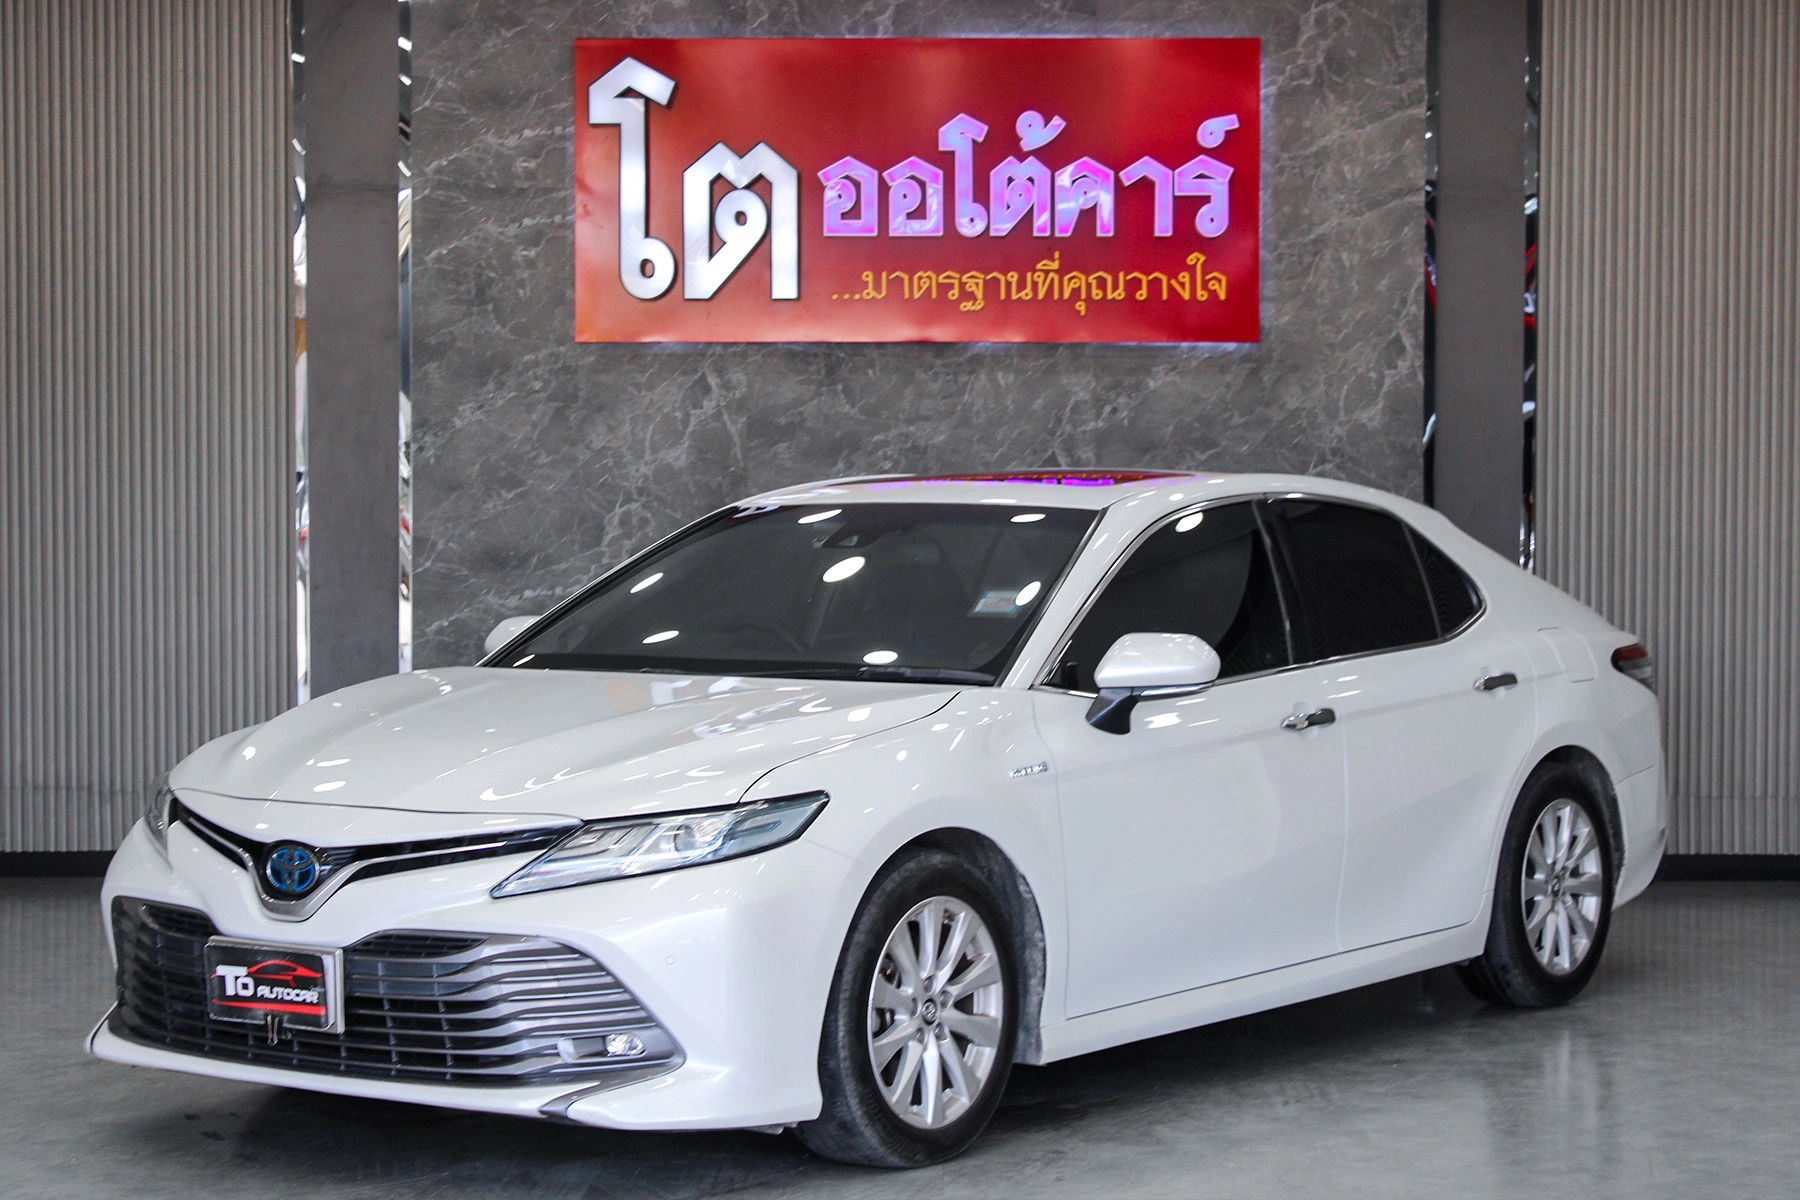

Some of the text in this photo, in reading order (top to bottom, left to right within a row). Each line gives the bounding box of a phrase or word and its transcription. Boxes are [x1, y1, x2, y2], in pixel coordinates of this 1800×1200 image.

[588, 56, 1240, 300] โต ออโต้คาร์
[256, 984, 319, 1004] AUTOCAR
